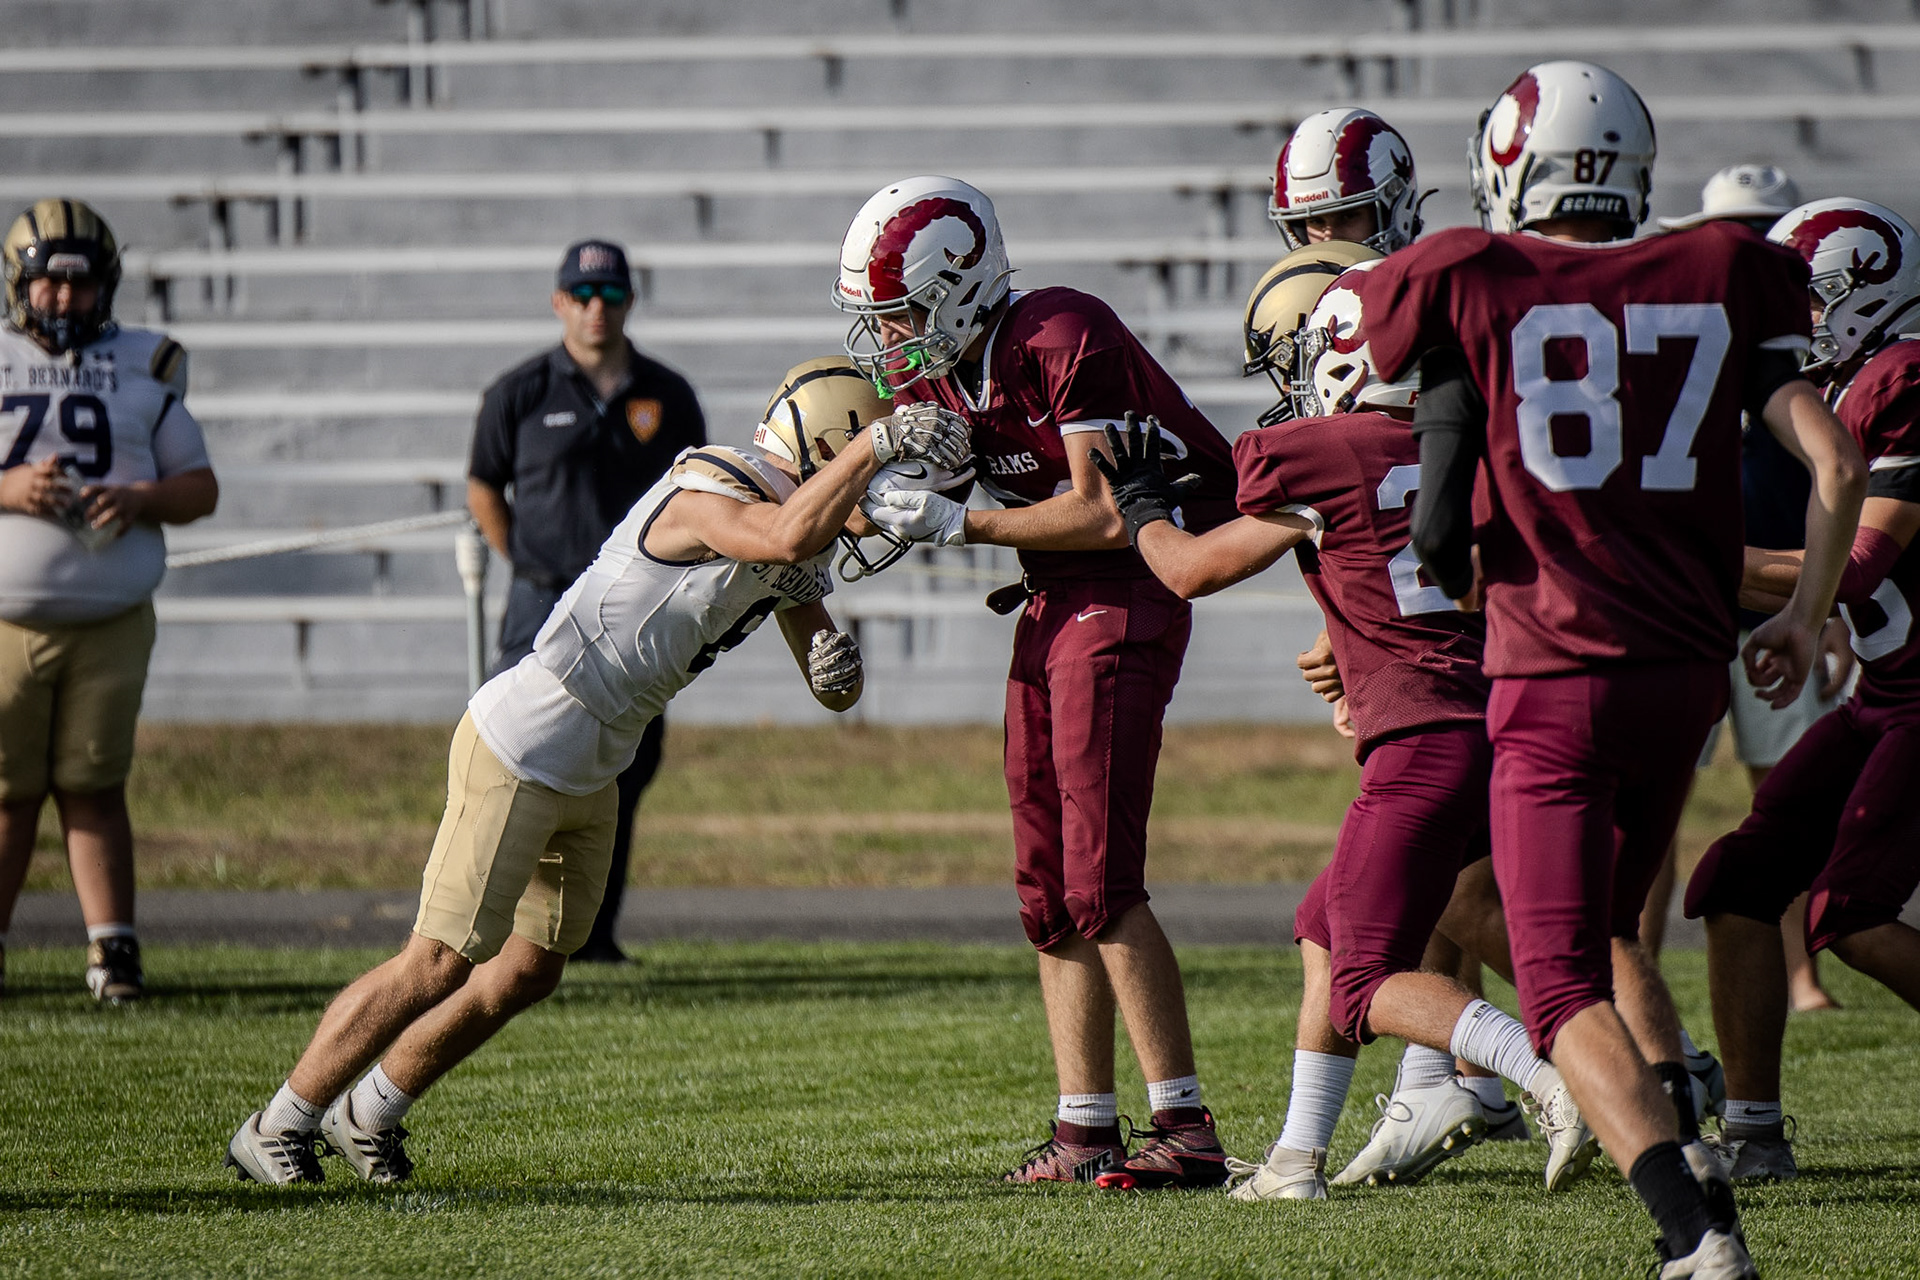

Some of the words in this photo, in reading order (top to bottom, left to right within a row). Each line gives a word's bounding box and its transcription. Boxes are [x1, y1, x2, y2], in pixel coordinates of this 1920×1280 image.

[1574, 149, 1619, 186] 87
[1294, 190, 1329, 204] Riddell
[1511, 302, 1733, 491] 87
[0, 394, 112, 478] 79
[985, 451, 1039, 475] RAMS
